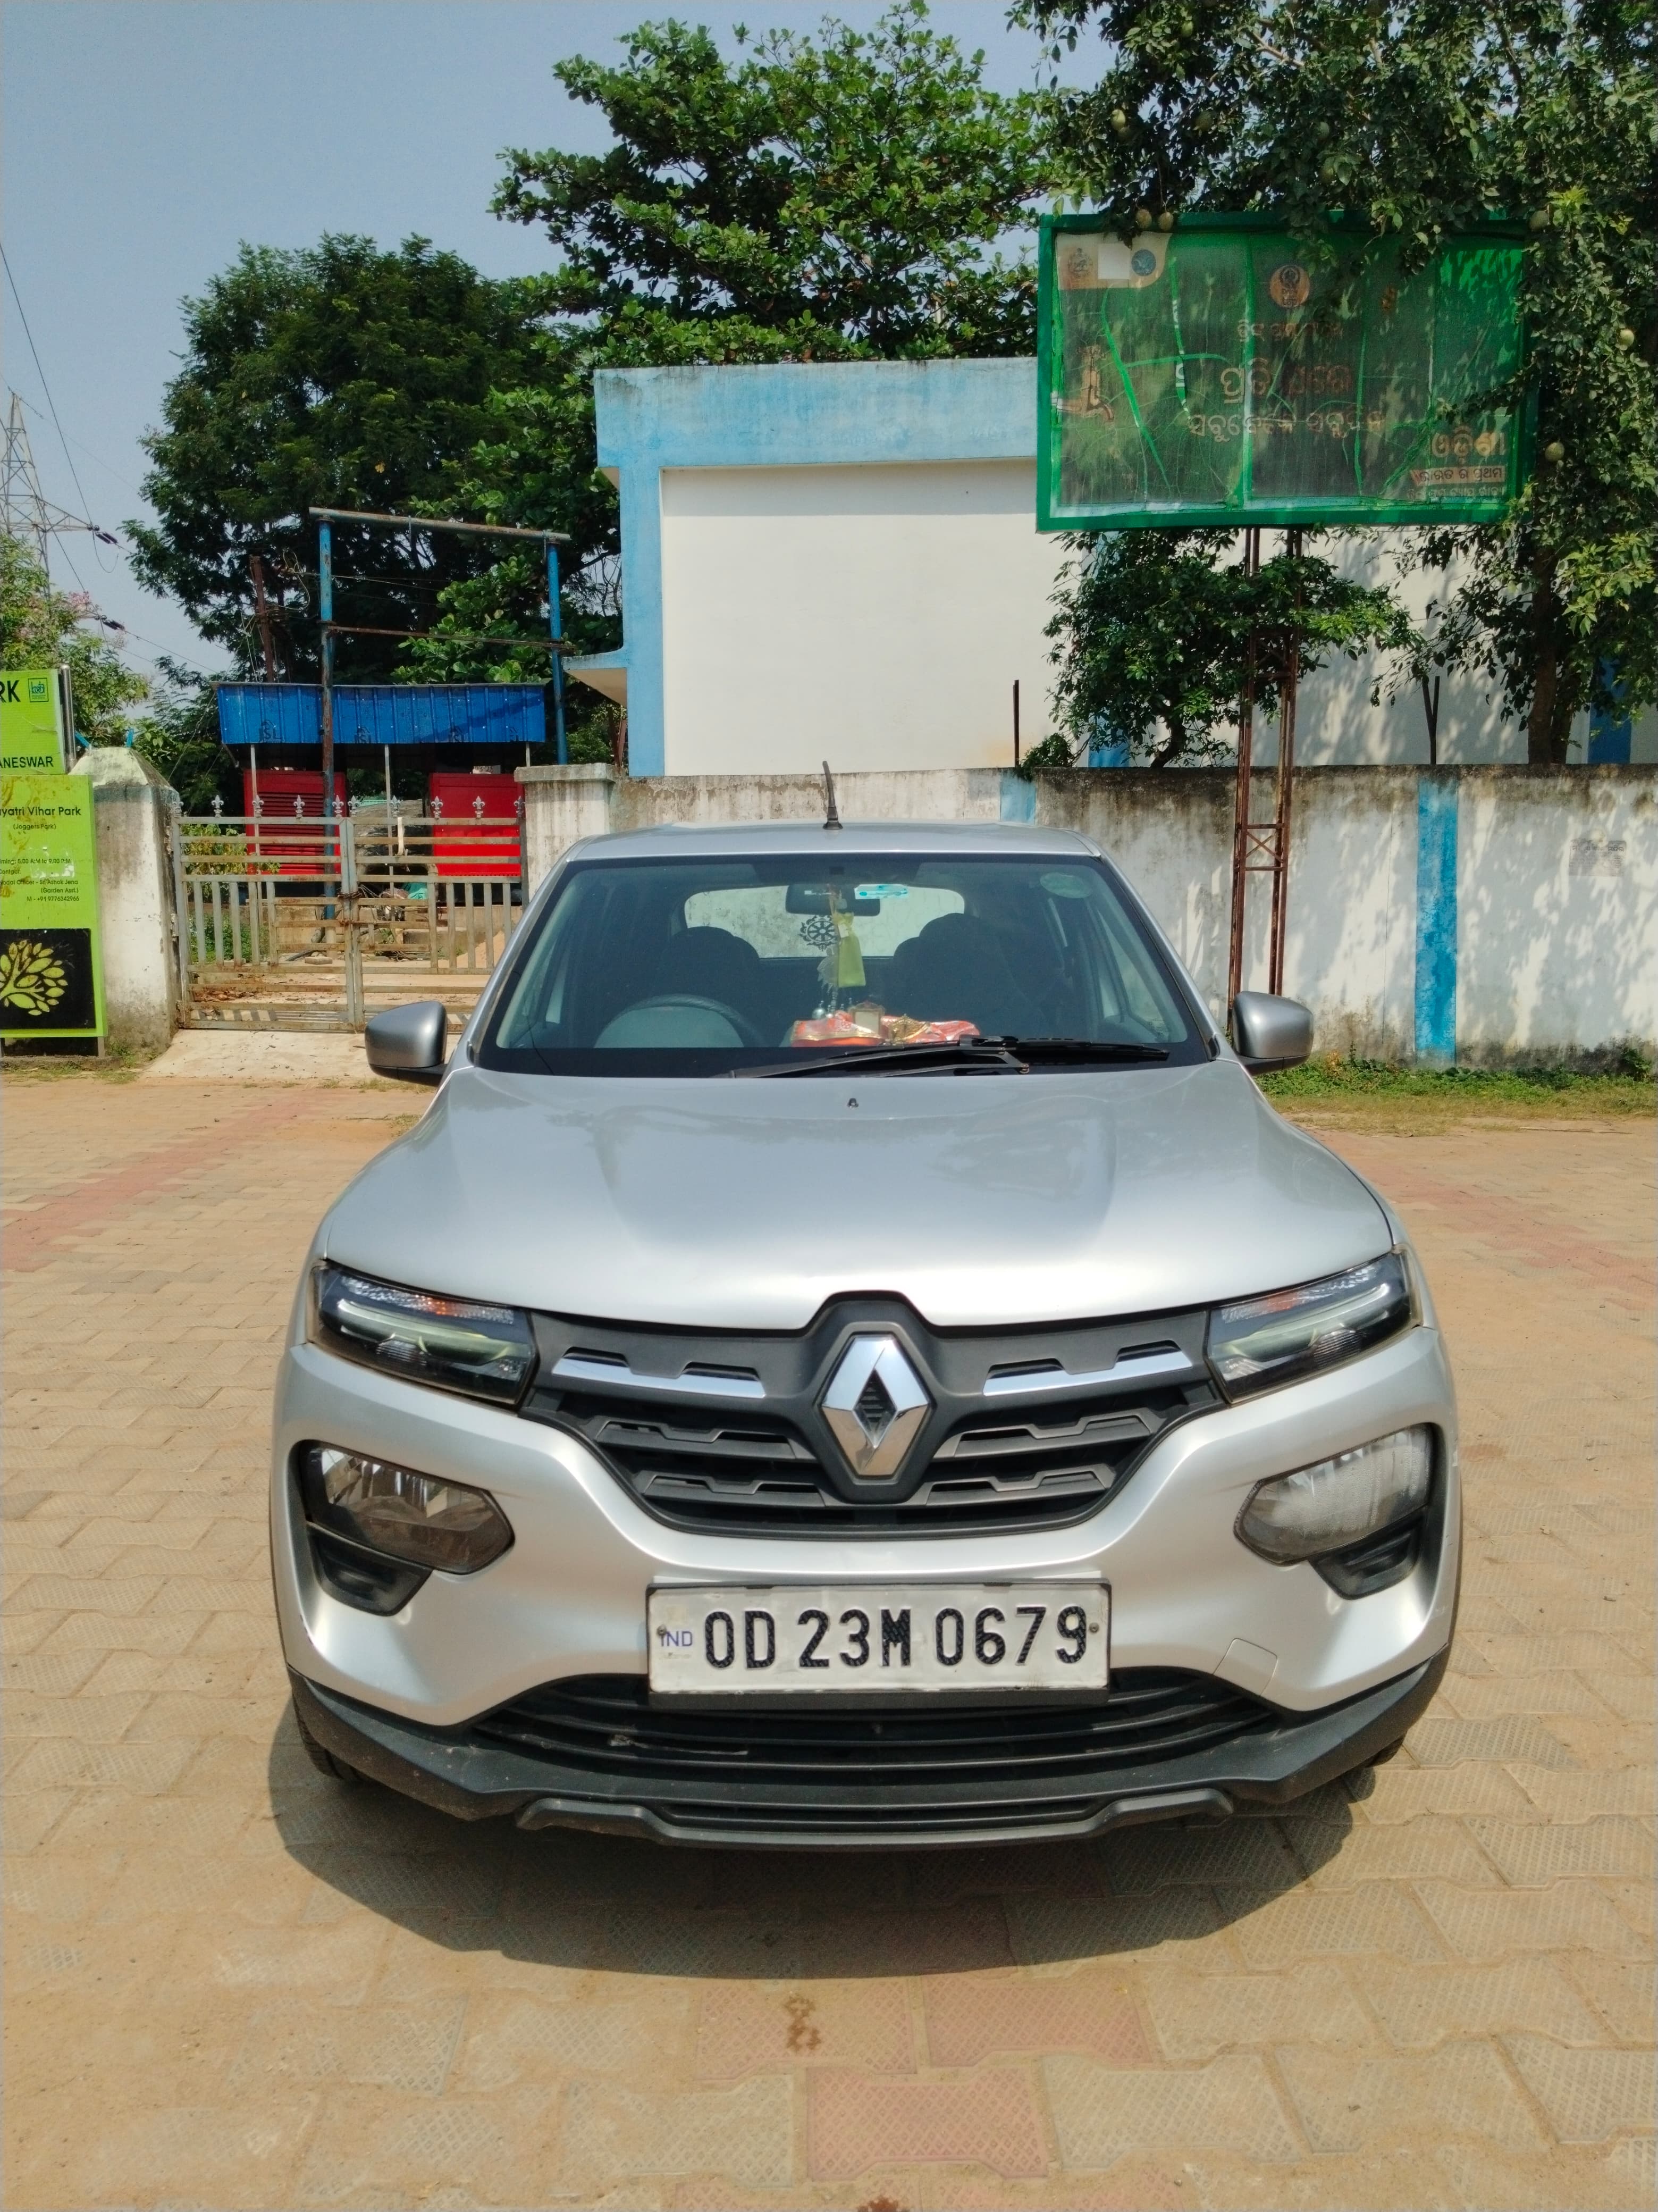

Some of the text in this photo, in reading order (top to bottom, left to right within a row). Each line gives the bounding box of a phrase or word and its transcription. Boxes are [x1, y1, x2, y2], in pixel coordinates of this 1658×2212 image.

[0, 807, 81, 817] yatri Vihar Park
[661, 1631, 693, 1647] IND
[935, 1605, 1087, 1667] 0679
